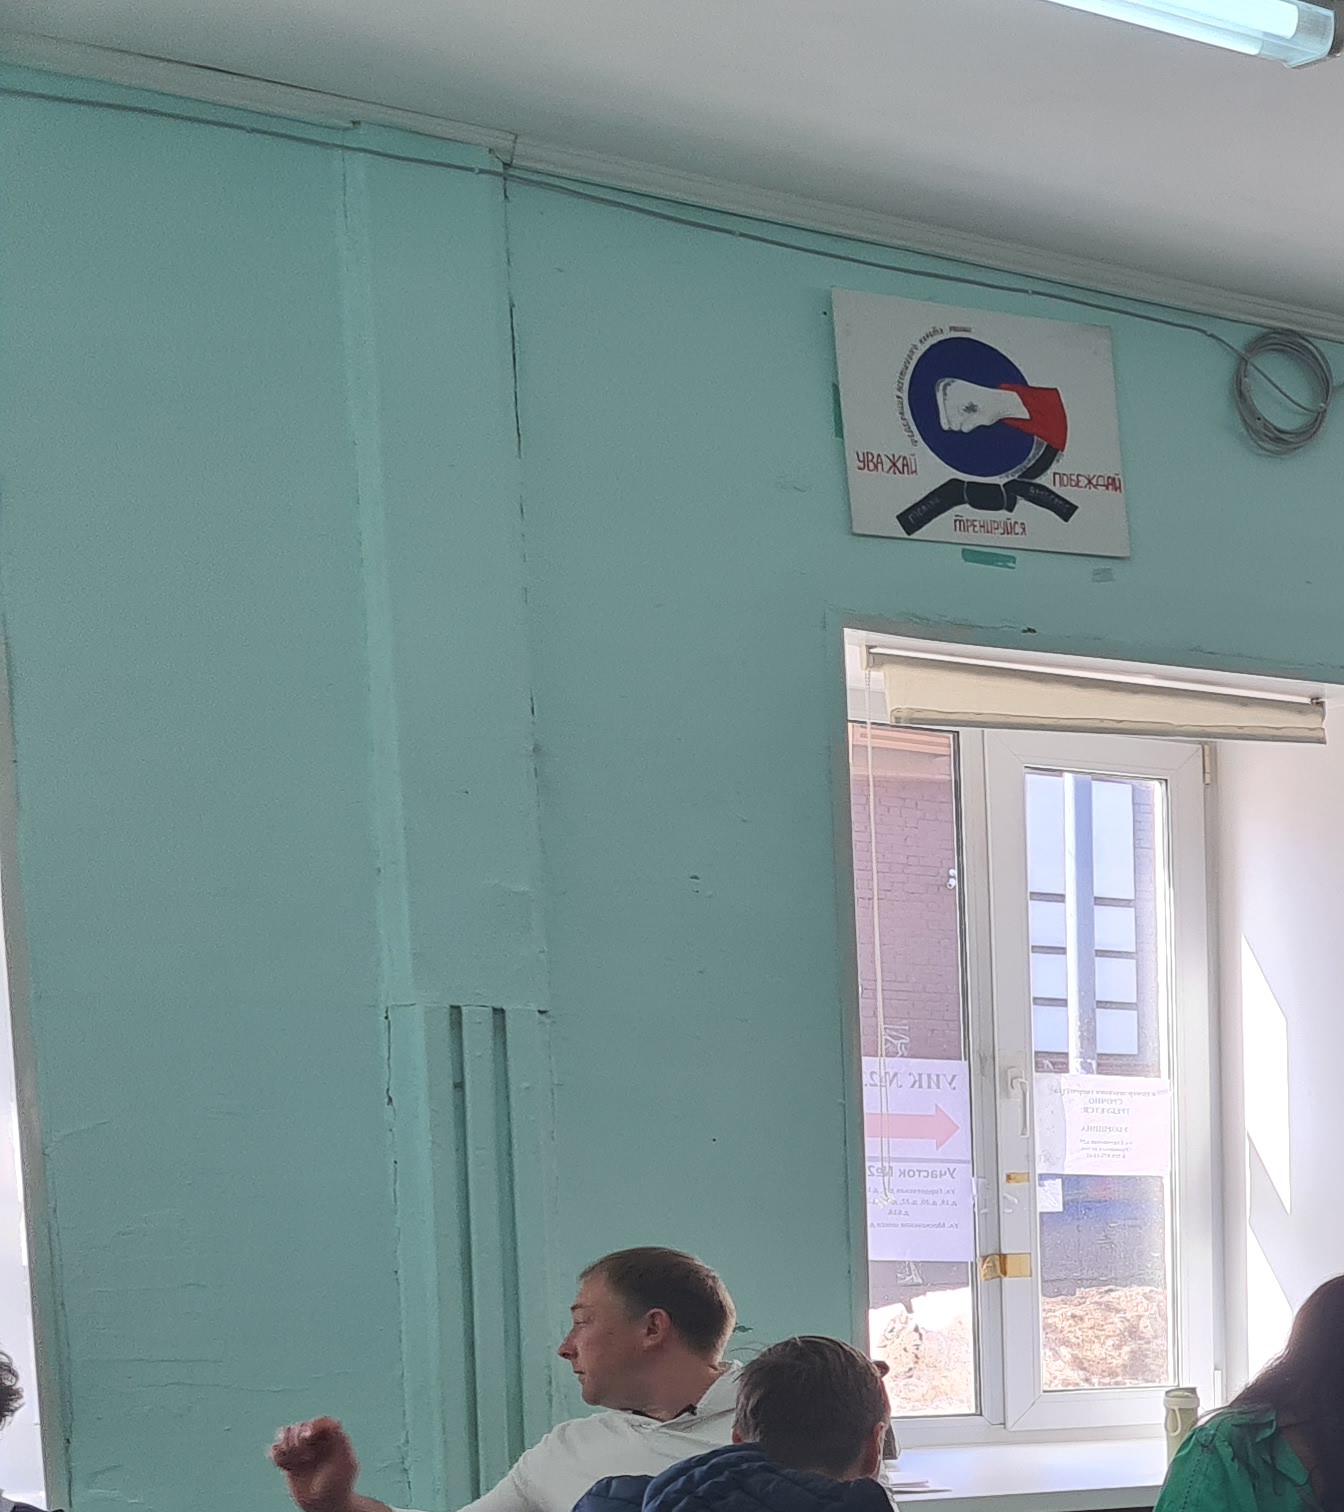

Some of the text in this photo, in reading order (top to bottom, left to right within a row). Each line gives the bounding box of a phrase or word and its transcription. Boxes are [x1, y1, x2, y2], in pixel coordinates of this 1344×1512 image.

[856, 451, 918, 476] УВАЖАЙ
[1053, 472, 1122, 494] ПОБЕЖДАЙ
[954, 515, 1027, 536] ТРЕНИРУЙСЯ
